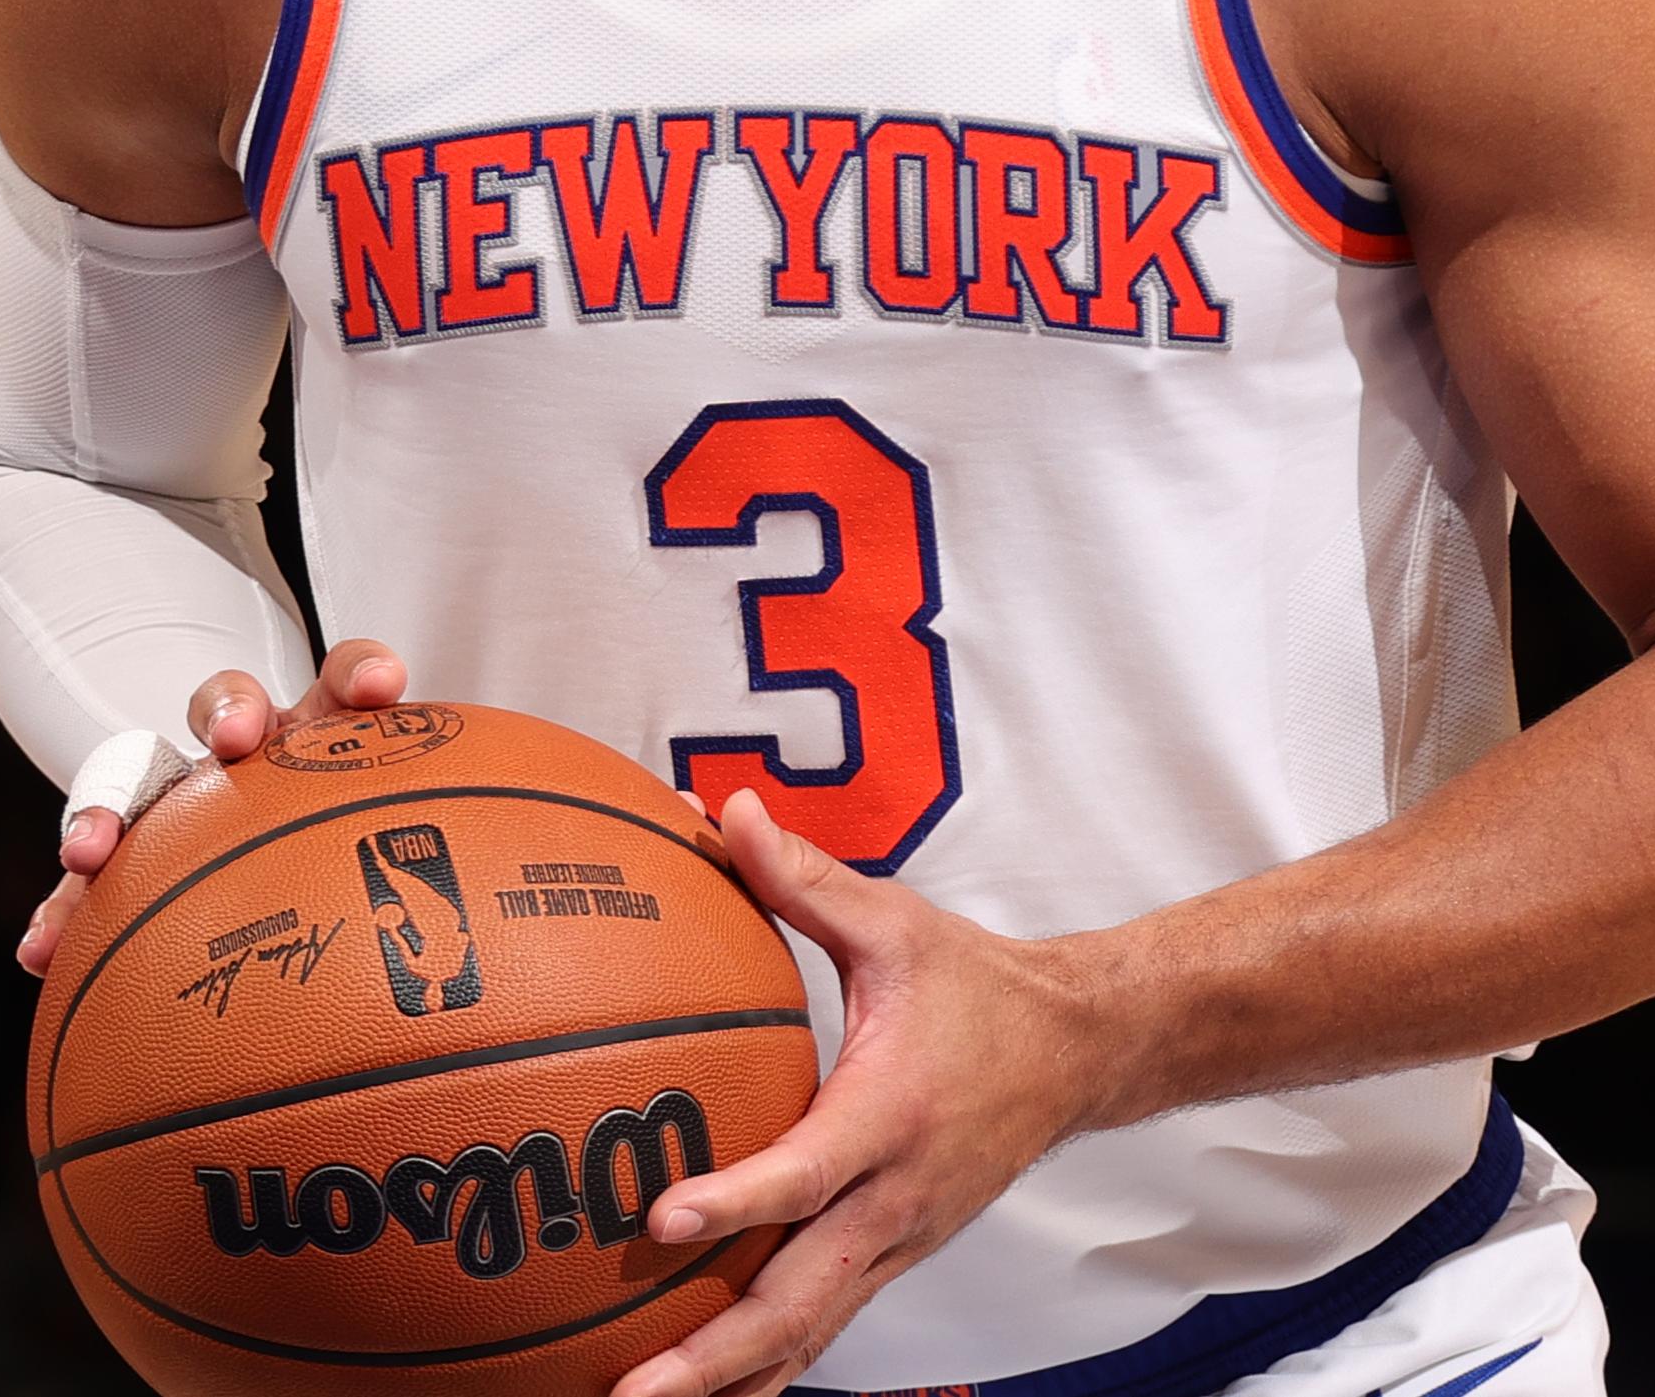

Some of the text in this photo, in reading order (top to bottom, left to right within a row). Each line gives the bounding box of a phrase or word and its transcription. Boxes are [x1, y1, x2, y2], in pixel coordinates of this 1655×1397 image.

[314, 105, 1232, 351] NEW YORK
[644, 398, 963, 878] 3
[389, 832, 439, 863] NBA
[519, 862, 626, 885] GENUINE LEATHER
[494, 887, 662, 921] OFFICIAL GAME BALL
[207, 907, 299, 962] COMMISSIONER
[194, 1088, 715, 1281] Wilson
